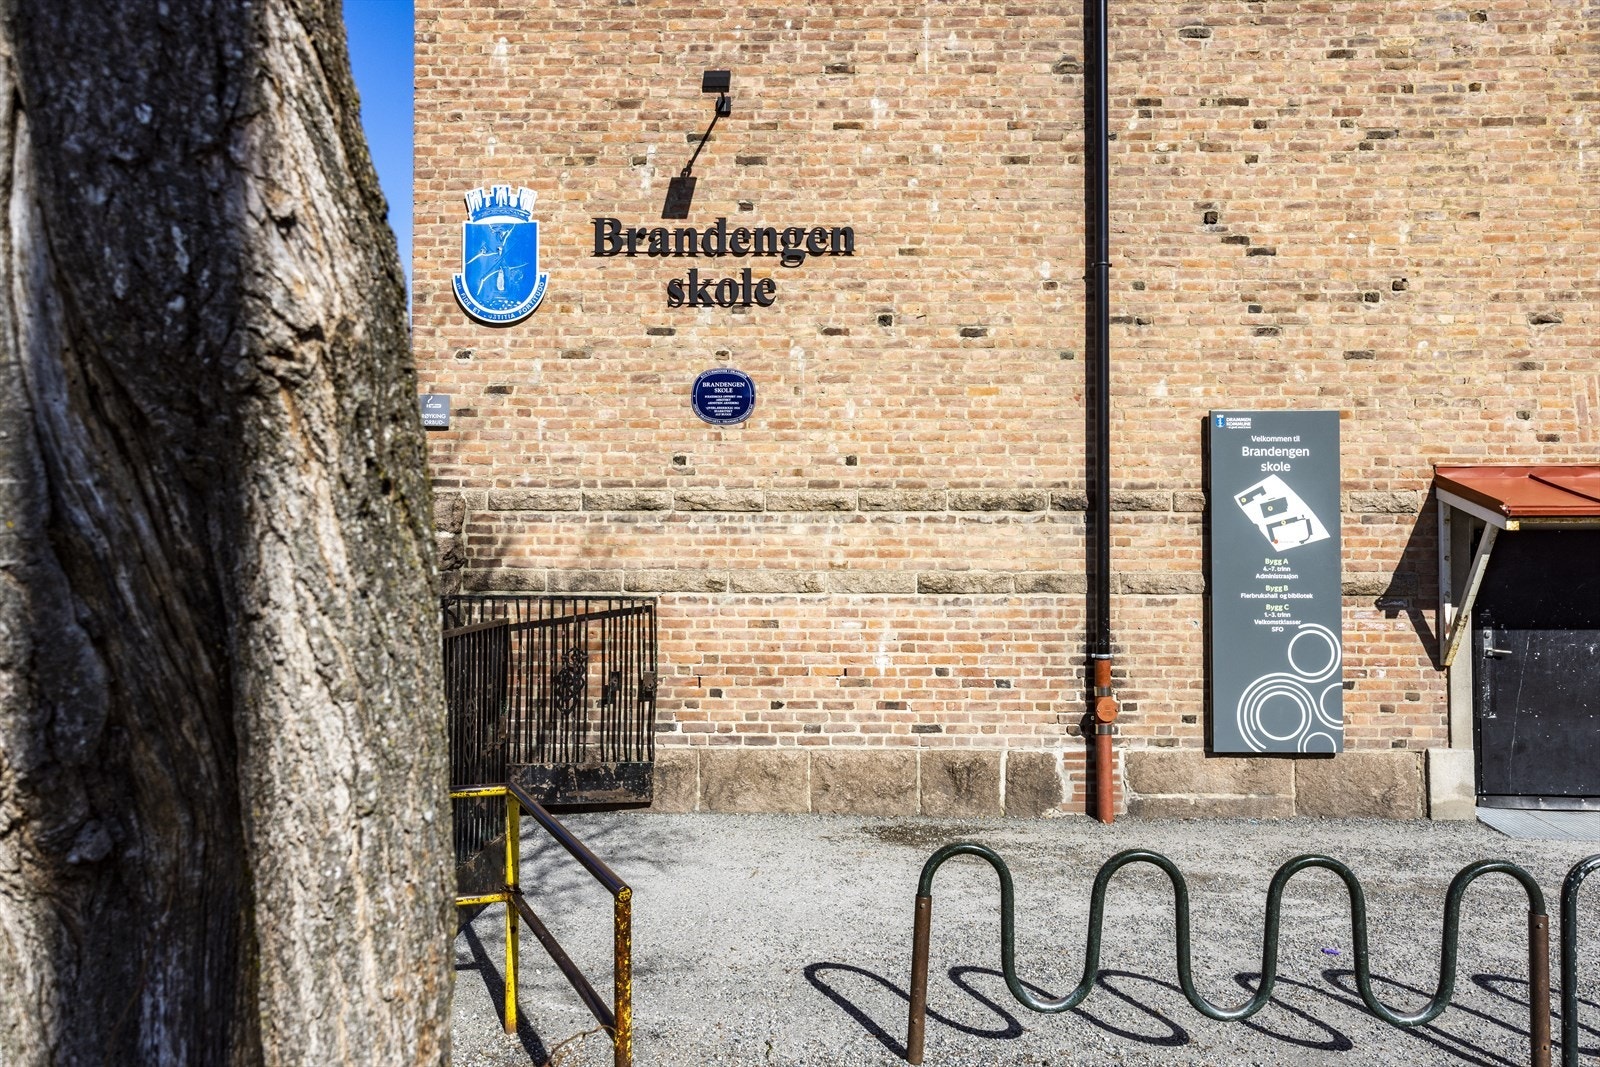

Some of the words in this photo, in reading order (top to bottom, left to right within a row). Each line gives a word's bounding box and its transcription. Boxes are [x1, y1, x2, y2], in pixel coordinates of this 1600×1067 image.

[591, 217, 855, 268] Brandengen
[667, 268, 777, 308] skole
[460, 292, 472, 307] FIDE
[472, 307, 482, 315] ET
[518, 281, 545, 316] FORTITUDO
[1242, 446, 1310, 458] Brandengen
[1260, 461, 1291, 472] skole
[1264, 558, 1282, 566] Bygg
[1265, 585, 1283, 593] Bygg
[1265, 604, 1283, 612] Bygg
